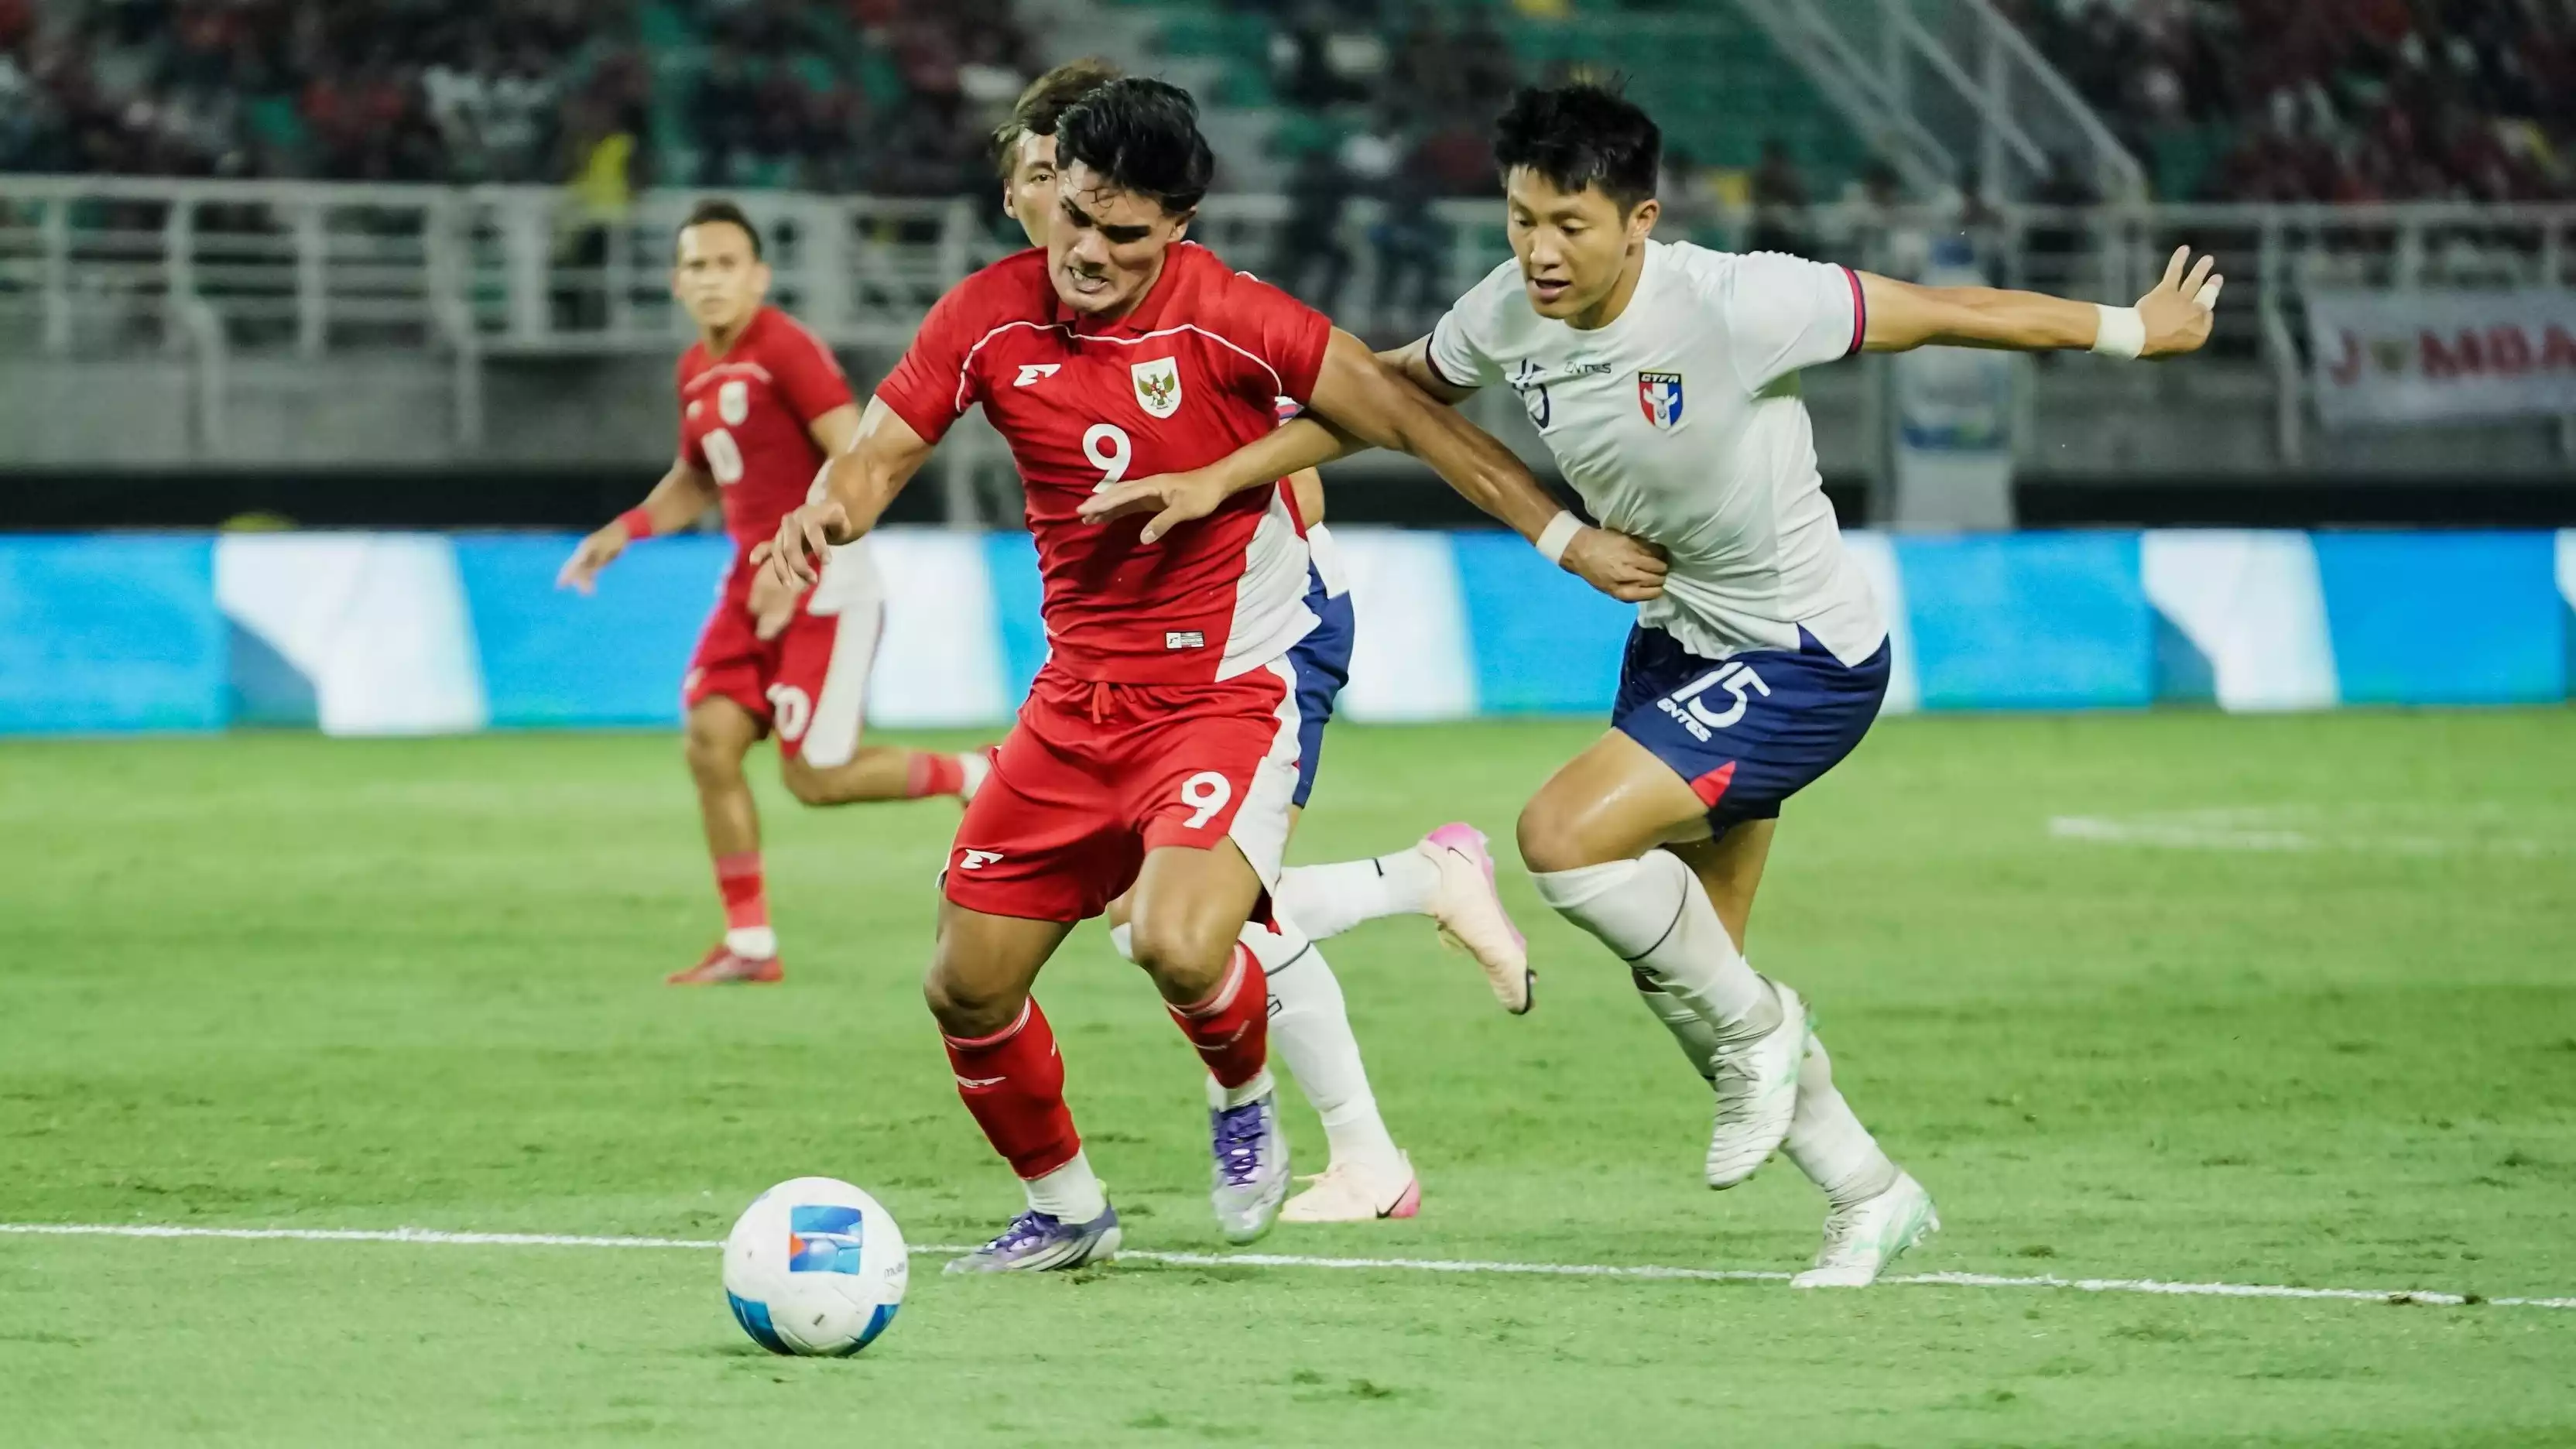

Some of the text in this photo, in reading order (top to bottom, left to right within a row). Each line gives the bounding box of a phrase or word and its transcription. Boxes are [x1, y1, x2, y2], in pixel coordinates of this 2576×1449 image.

[1641, 373, 1680, 384] CTFA
[1082, 423, 1132, 495] 9
[1671, 662, 1772, 728] 15
[1180, 771, 1232, 830] 9
